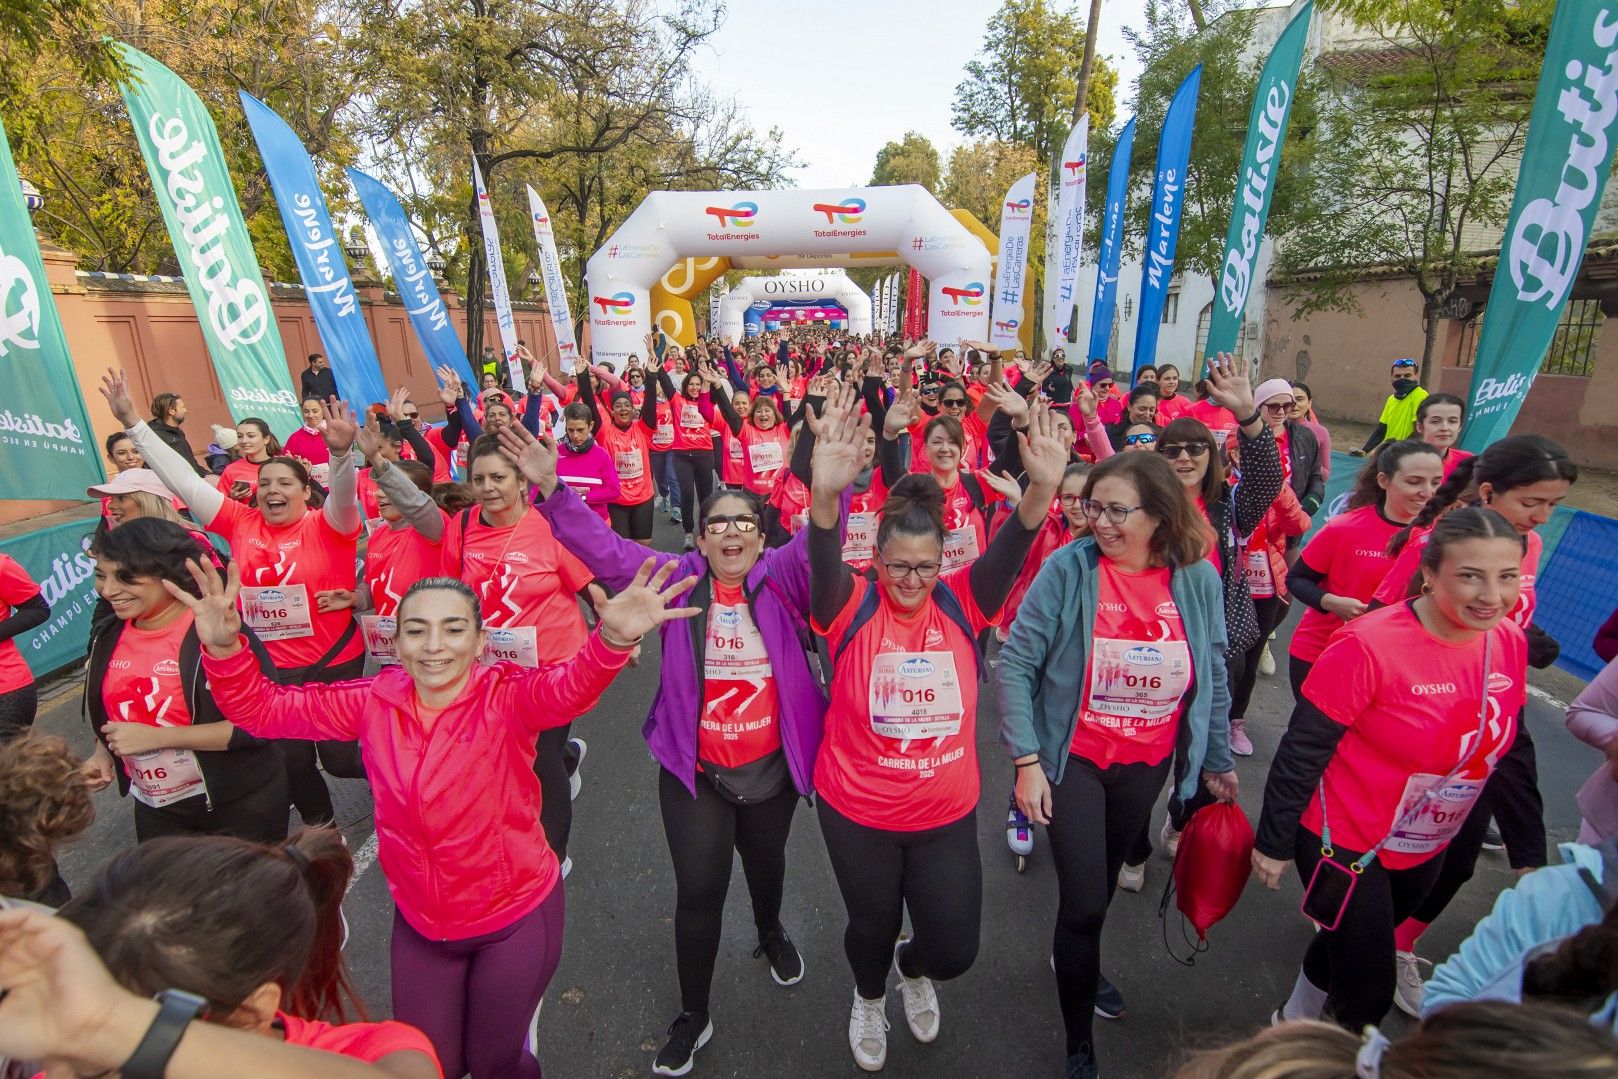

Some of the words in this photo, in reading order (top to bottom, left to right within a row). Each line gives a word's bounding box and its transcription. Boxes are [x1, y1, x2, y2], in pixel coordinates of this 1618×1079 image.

[814, 229, 867, 238] TotalEnergies
[1148, 169, 1178, 289] Marlene
[707, 232, 760, 241] TotalEnergies
[764, 279, 825, 294] OYSHO
[848, 533, 866, 541] 016
[944, 548, 965, 559] 016
[1245, 569, 1266, 578] 016
[263, 608, 288, 619] 016
[32, 601, 81, 650] CHAMPÚ
[382, 637, 394, 646] 01
[715, 637, 744, 649] 016
[494, 649, 518, 659] 016
[1126, 675, 1161, 689] 016
[1411, 683, 1456, 695] OYSHO
[902, 689, 935, 703] 016
[1099, 704, 1130, 712] OYSHO
[722, 722, 733, 732] DE
[734, 721, 745, 732] LA
[745, 716, 771, 731] MUJER
[1121, 718, 1132, 727] DE
[1133, 718, 1145, 727] LA
[878, 755, 916, 770] CARRERA
[917, 758, 930, 769] DE
[931, 757, 941, 768] LA
[941, 746, 965, 766] MUJER
